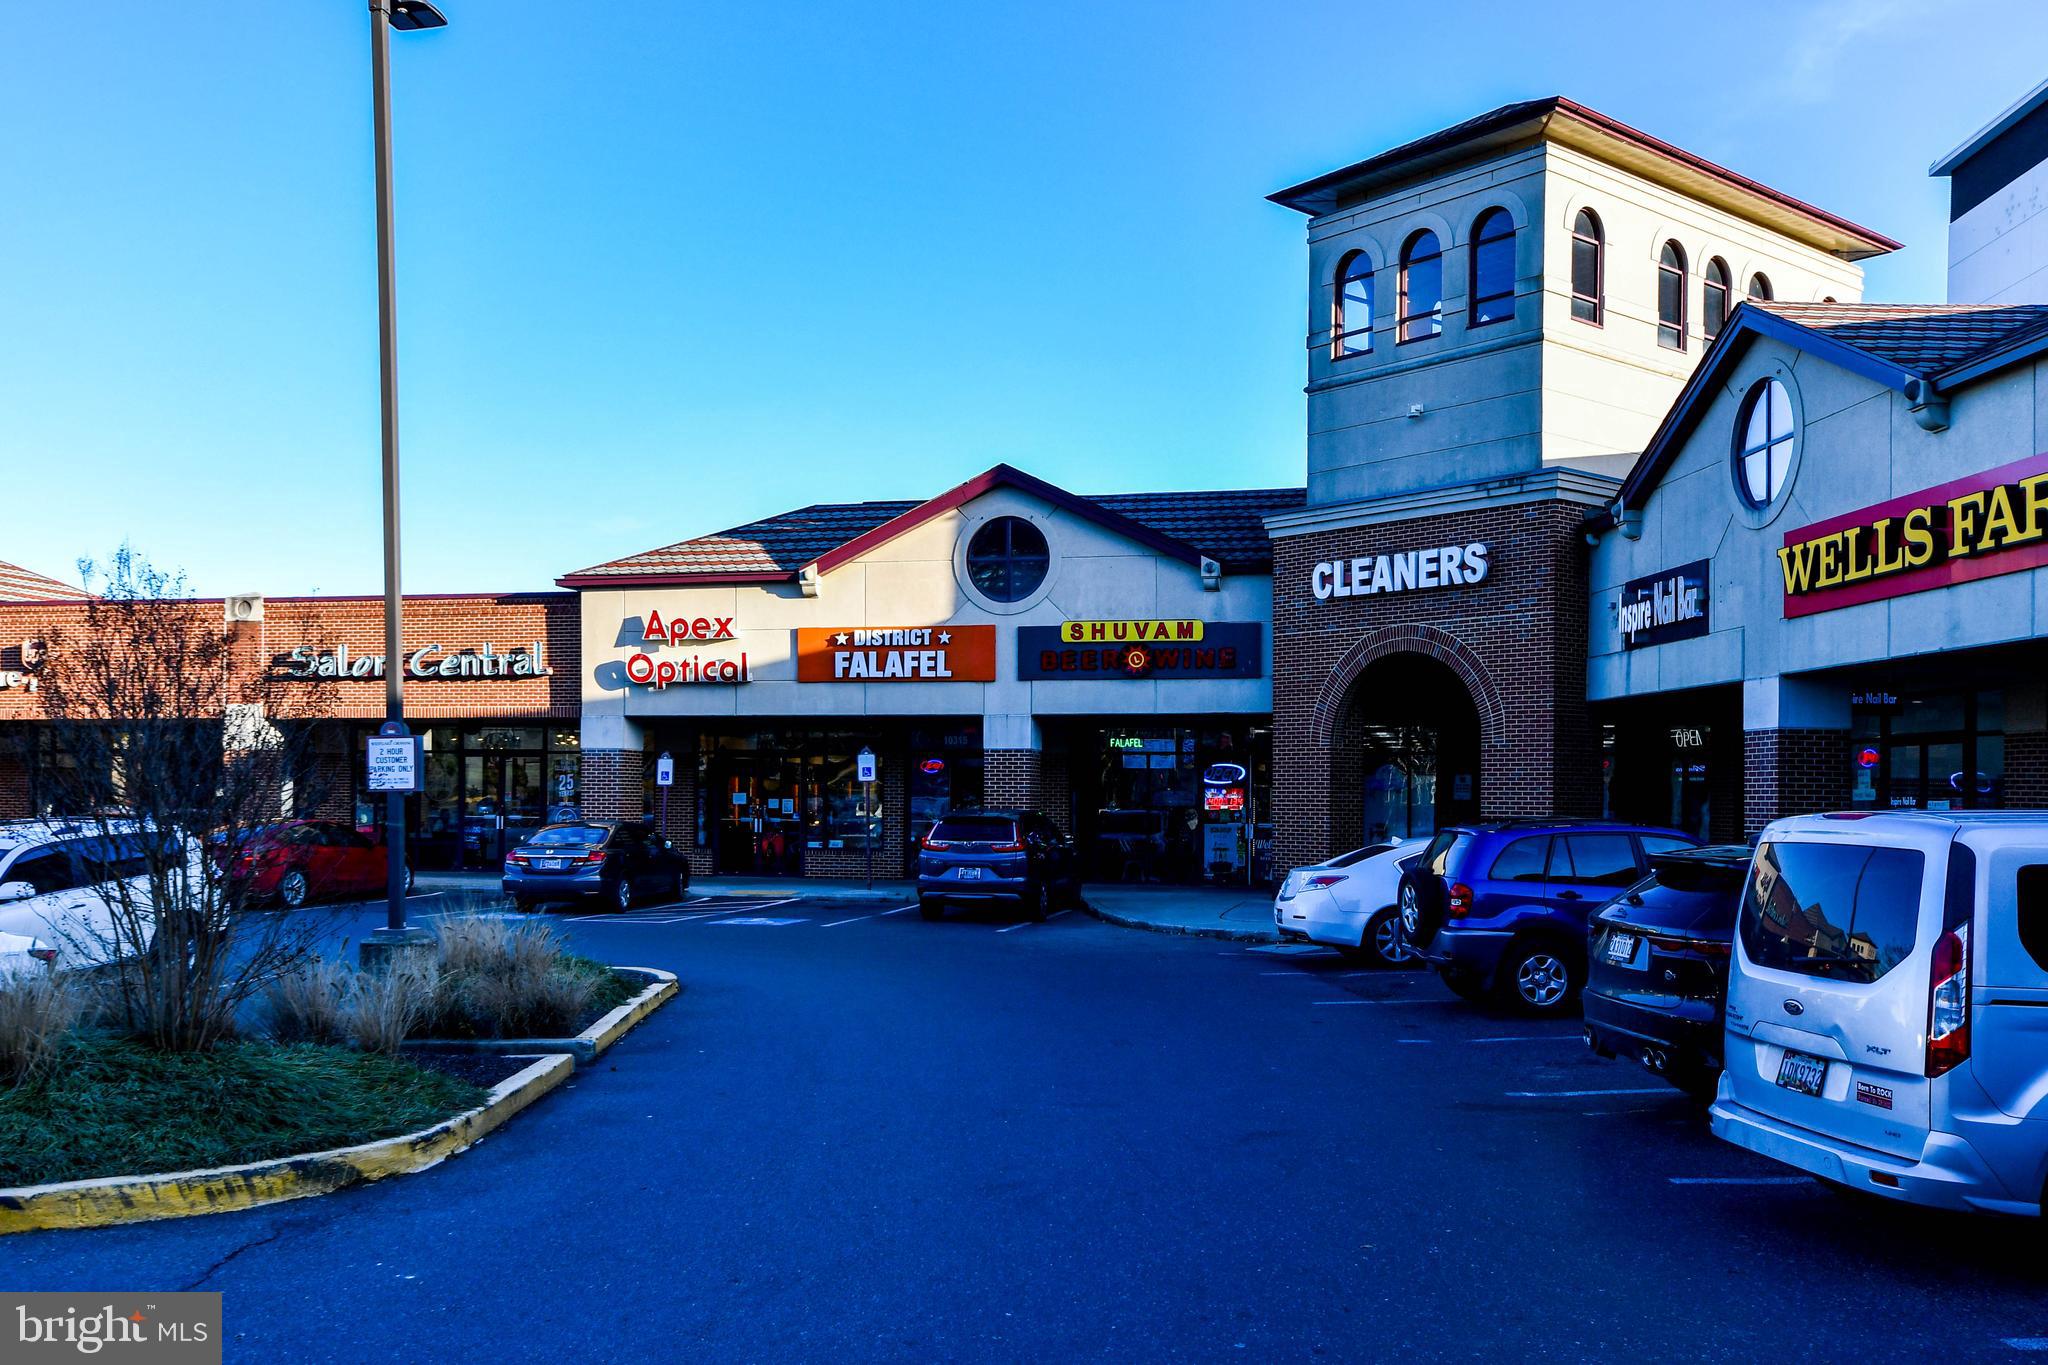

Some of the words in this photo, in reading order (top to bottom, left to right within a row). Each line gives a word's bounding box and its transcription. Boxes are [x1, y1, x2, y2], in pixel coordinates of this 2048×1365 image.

[1778, 506, 1934, 595] WELLS
[1312, 542, 1488, 599] CLEANERS
[1619, 589, 1652, 643] Inspire
[1653, 577, 1676, 626] Nail
[1677, 576, 1698, 620] Bar
[643, 610, 734, 646] Apex
[1070, 622, 1194, 640] SHUVAM
[853, 629, 932, 647] DISTRICT
[409, 641, 549, 677] Central
[834, 650, 953, 679] FALAFEL
[1040, 649, 1119, 672] BEER
[1152, 646, 1237, 670] WINE
[627, 652, 749, 690] Optical
[1866, 693, 1881, 704] Nail
[1883, 693, 1897, 704] Bar
[380, 748, 385, 756] 2
[387, 747, 404, 755] HOUR
[1110, 738, 1143, 748] FALAFEL
[369, 765, 396, 773] PARKING
[398, 765, 414, 773] ONLY
[376, 756, 408, 764] CUSTOMER
[559, 774, 574, 790] 25
[1866, 1045, 1891, 1055] XLT
[1876, 1088, 1893, 1098] ROCK
